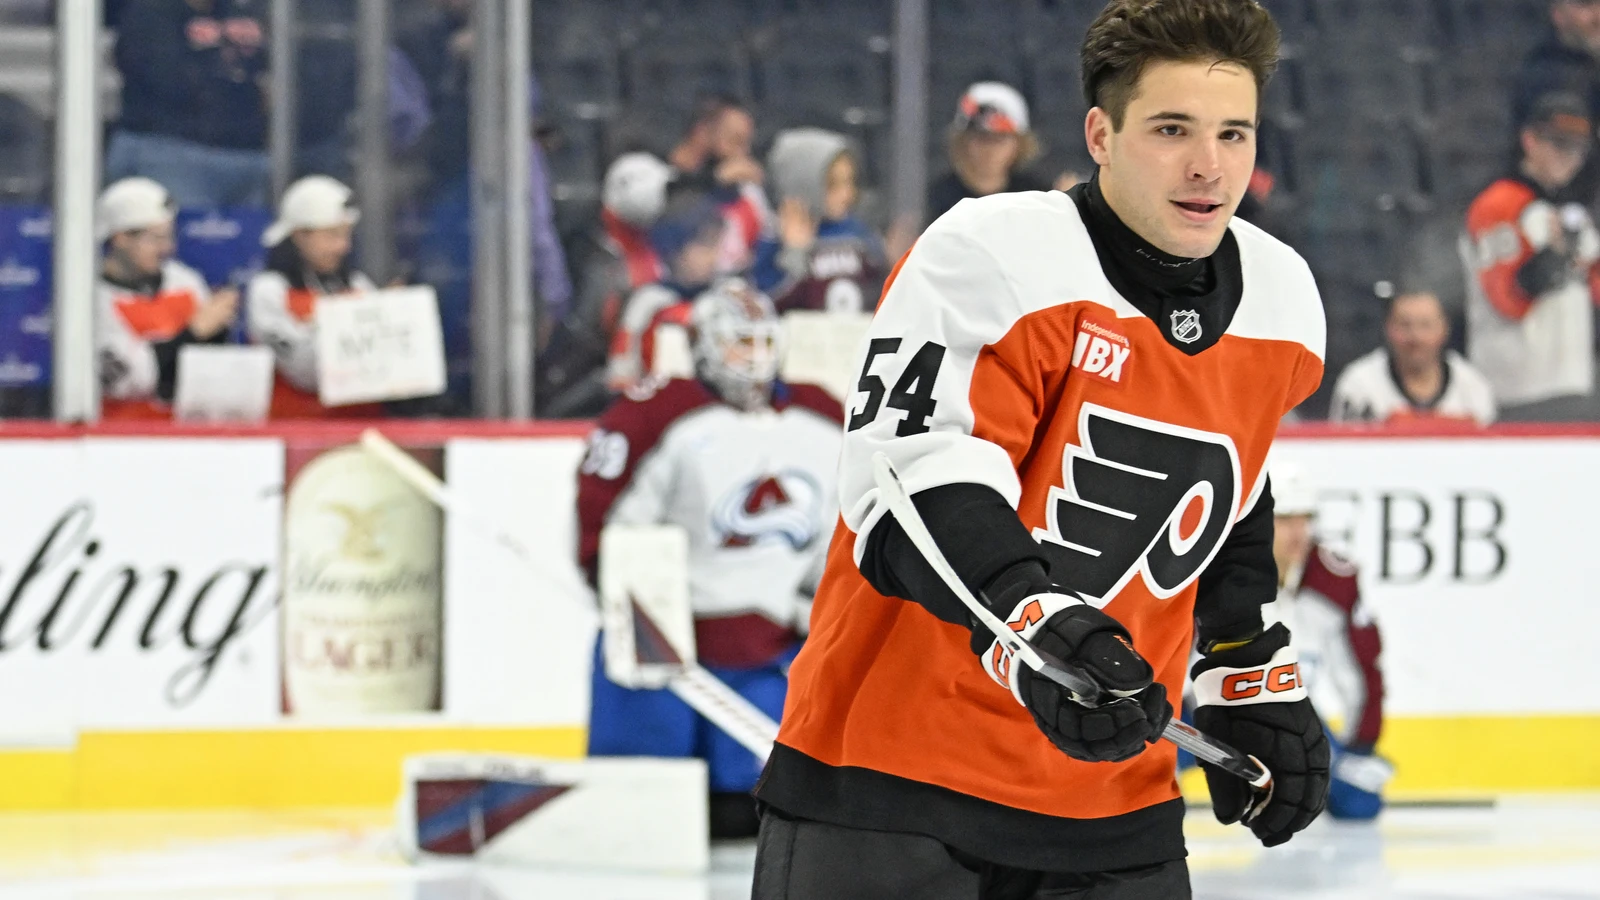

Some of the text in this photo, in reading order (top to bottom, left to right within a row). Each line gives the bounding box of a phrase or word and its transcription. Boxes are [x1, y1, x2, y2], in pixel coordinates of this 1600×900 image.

[1071, 331, 1130, 383] IBX
[848, 337, 947, 438] 54
[1221, 662, 1303, 701] CC
